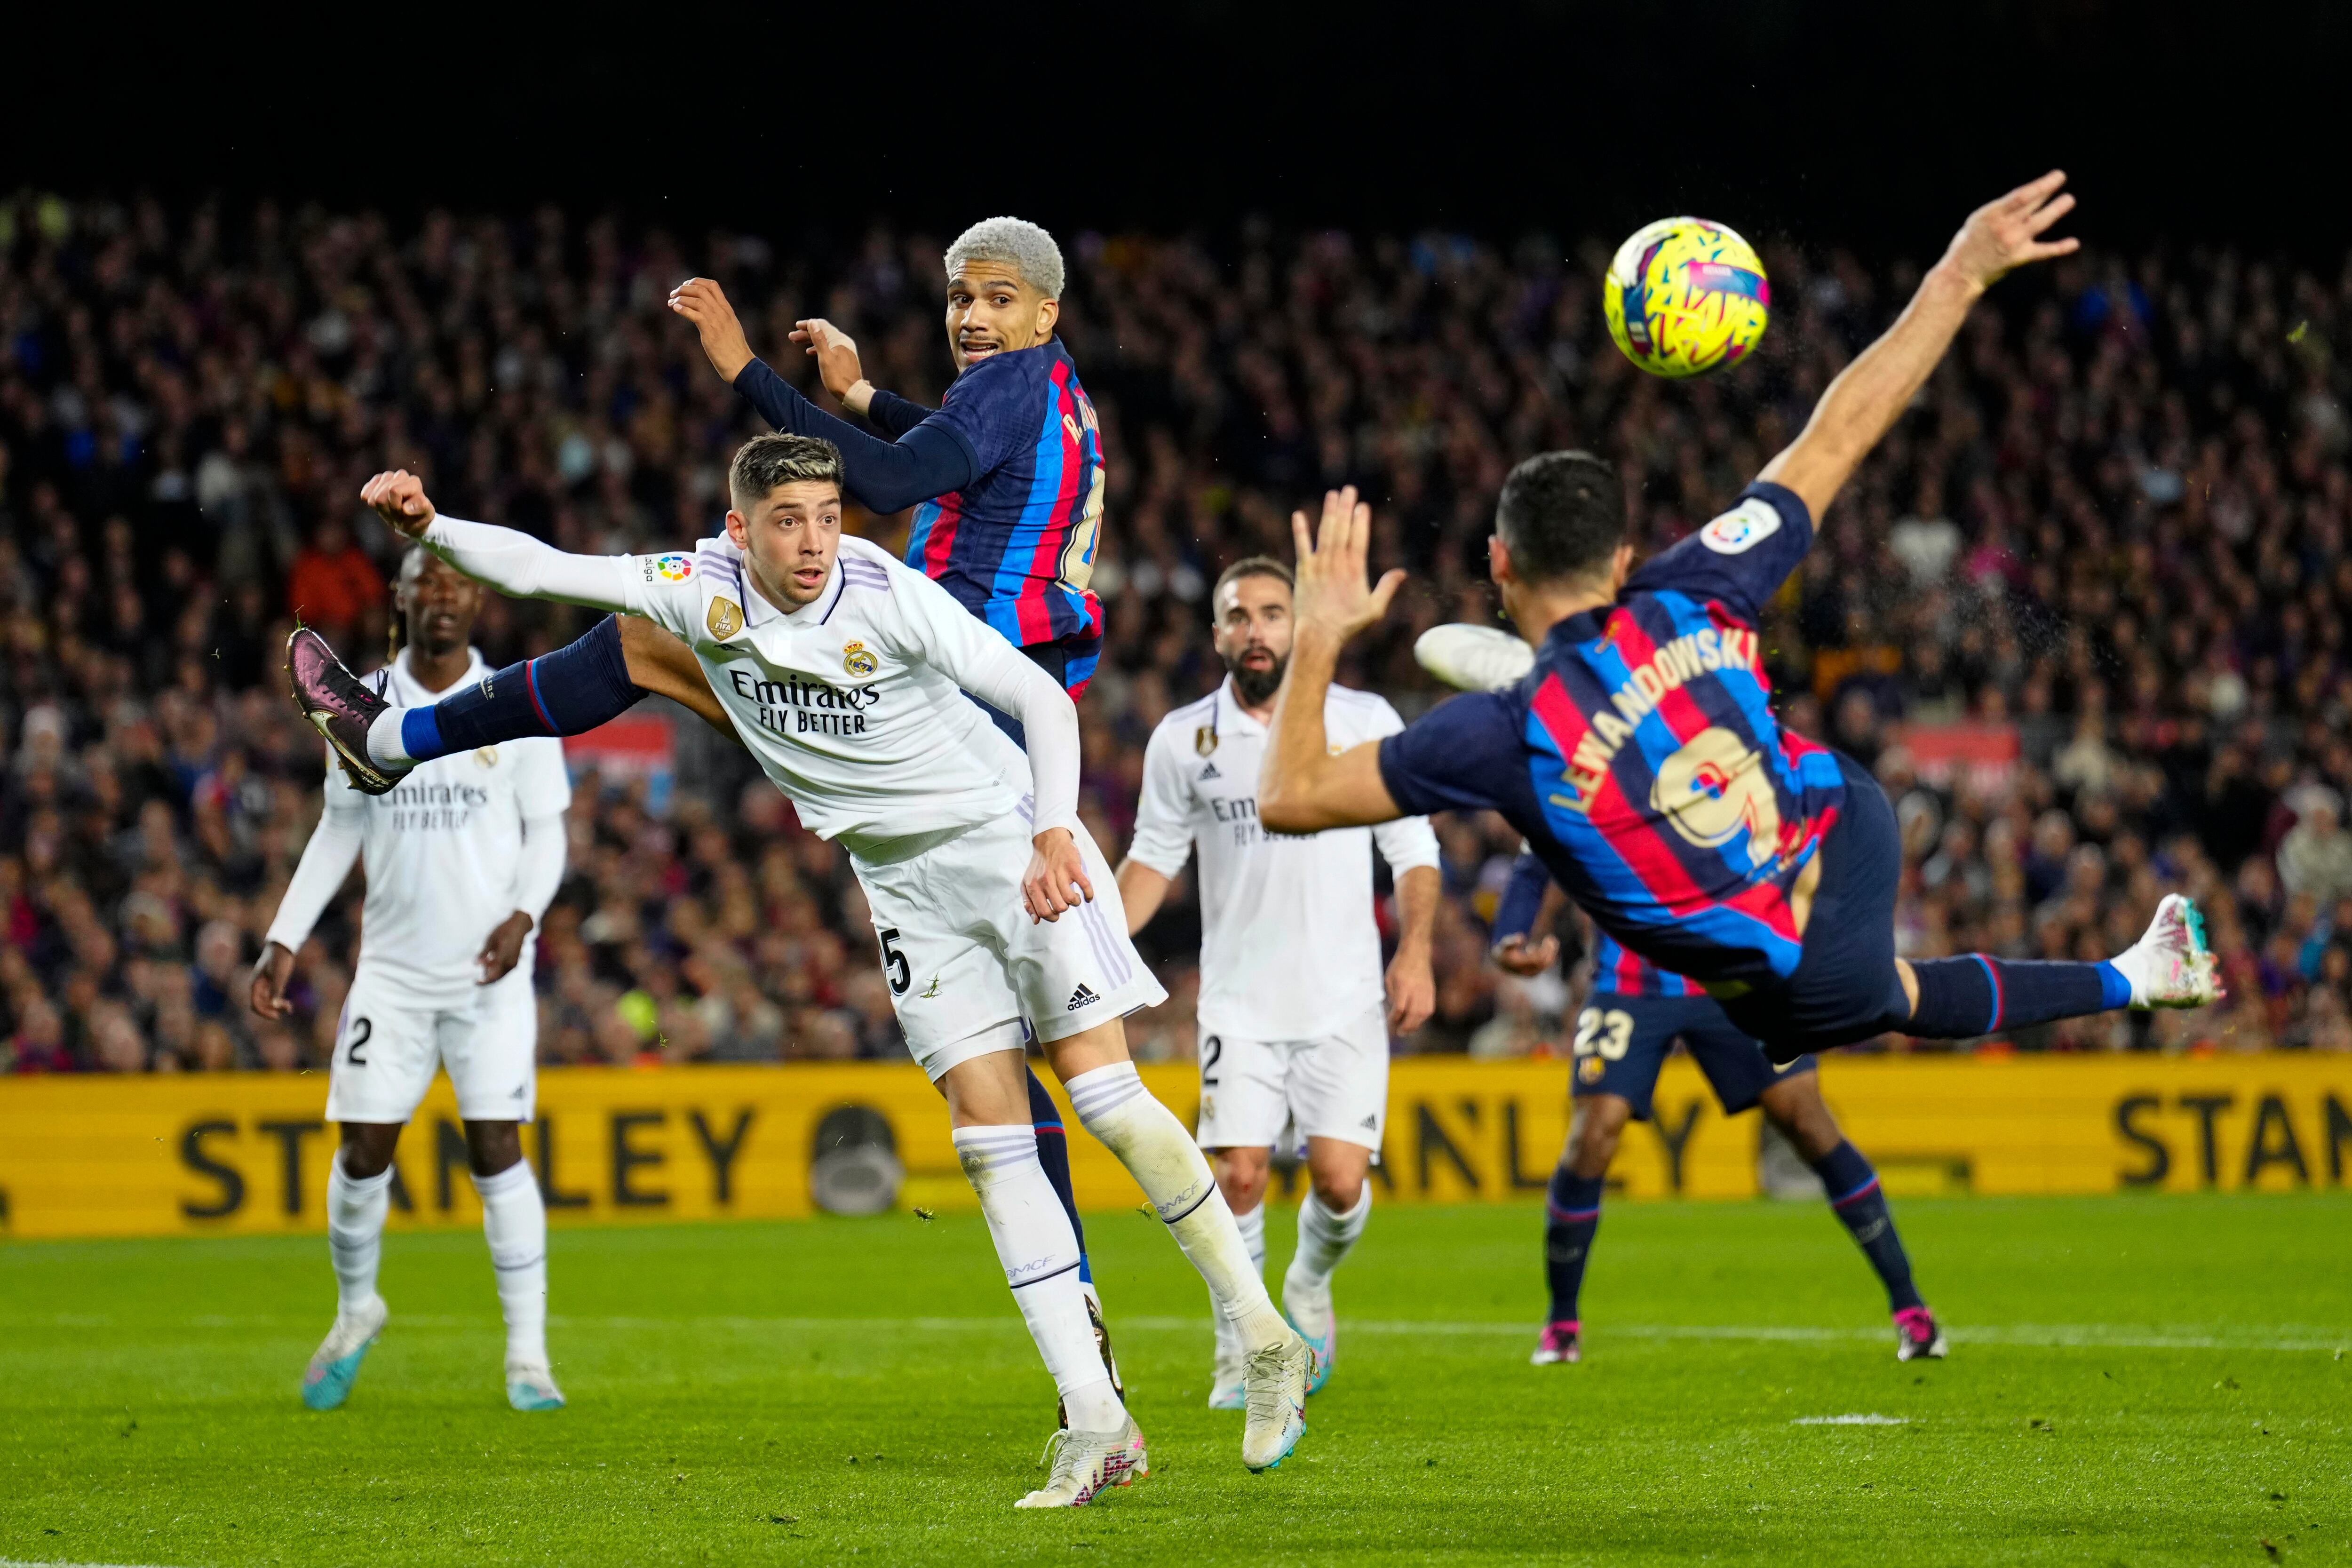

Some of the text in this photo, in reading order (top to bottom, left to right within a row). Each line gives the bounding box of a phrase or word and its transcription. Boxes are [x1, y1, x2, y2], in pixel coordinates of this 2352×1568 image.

[715, 621, 731, 631] FIFA
[728, 669, 880, 711] Emirates
[760, 707, 866, 735] FLY BETTER
[1548, 627, 1758, 814] LEWANDOWSKI
[1650, 726, 1779, 868] 9
[1067, 994, 1100, 1011] adidas
[347, 1017, 372, 1066] 2
[1573, 1007, 1635, 1061] 23
[1203, 1035, 1222, 1086] 2
[1156, 1178, 1200, 1214] RMCF
[1006, 1254, 1056, 1278] RMCF
